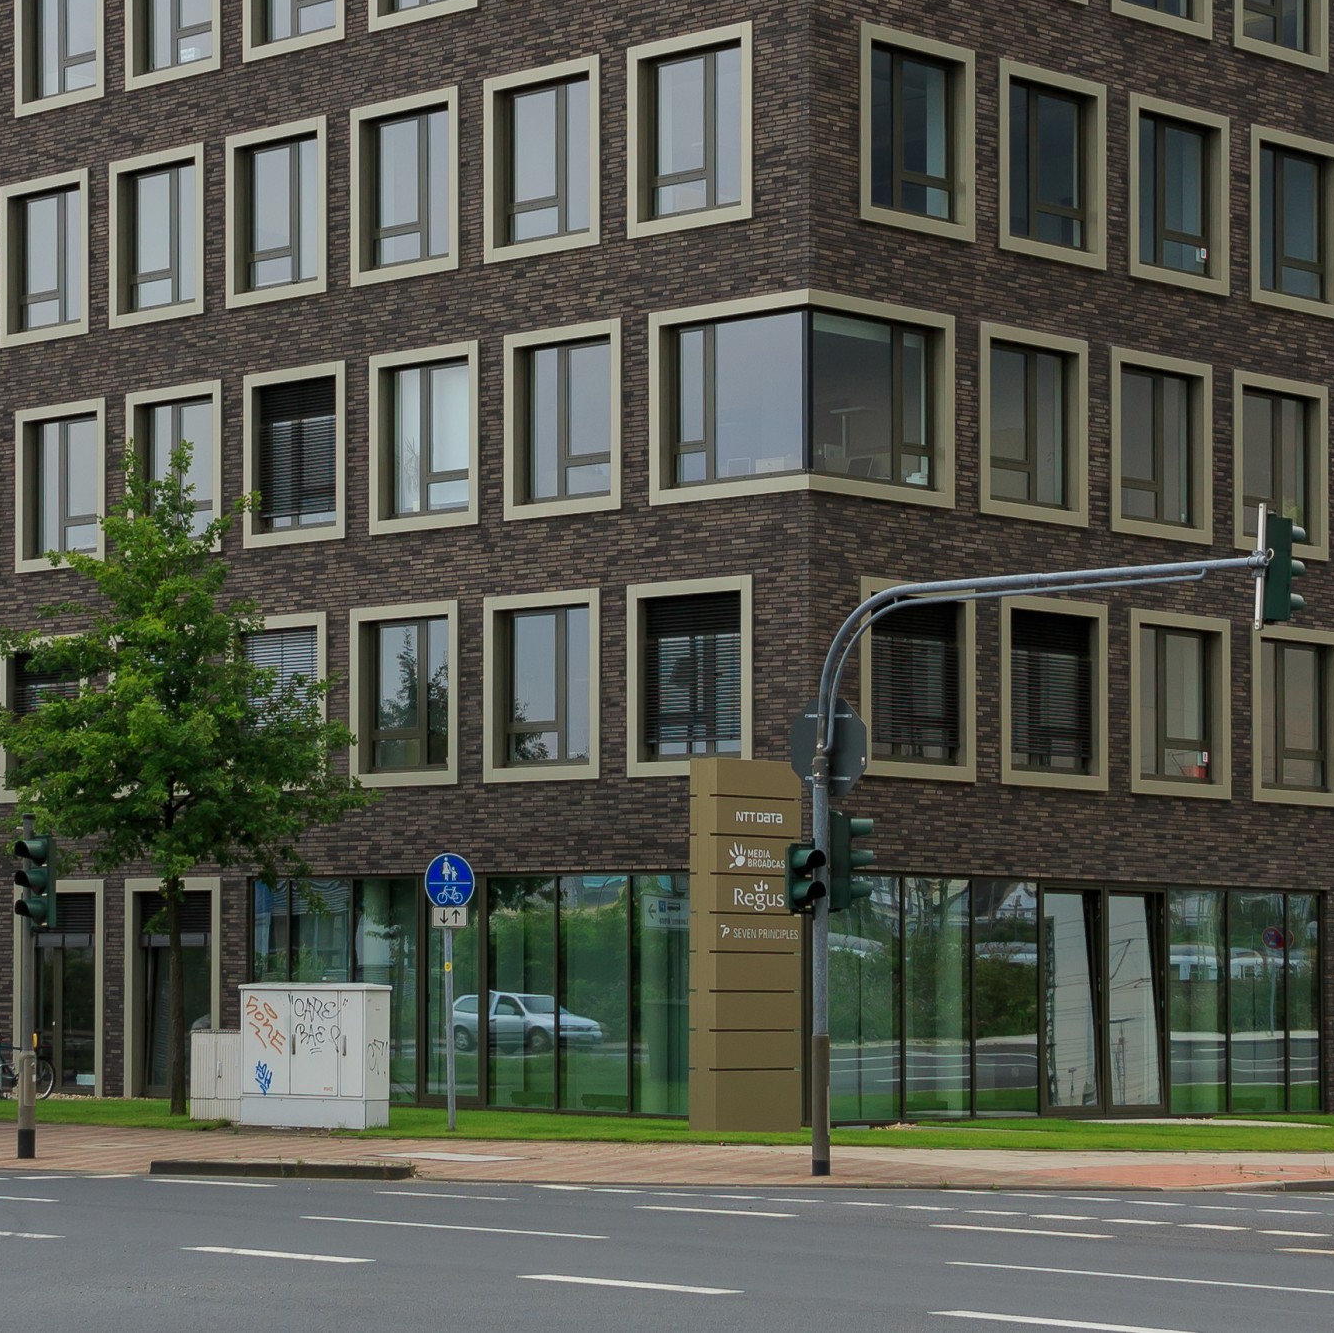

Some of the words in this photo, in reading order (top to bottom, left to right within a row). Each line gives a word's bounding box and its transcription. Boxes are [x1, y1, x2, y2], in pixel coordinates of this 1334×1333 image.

[735, 811, 756, 823] NTT
[747, 849, 771, 859] MEDIA
[747, 858, 786, 869] BROADCAS
[733, 887, 785, 912] Regus
[733, 928, 757, 939] SEVEN
[758, 928, 799, 940] PRINCIPLES
